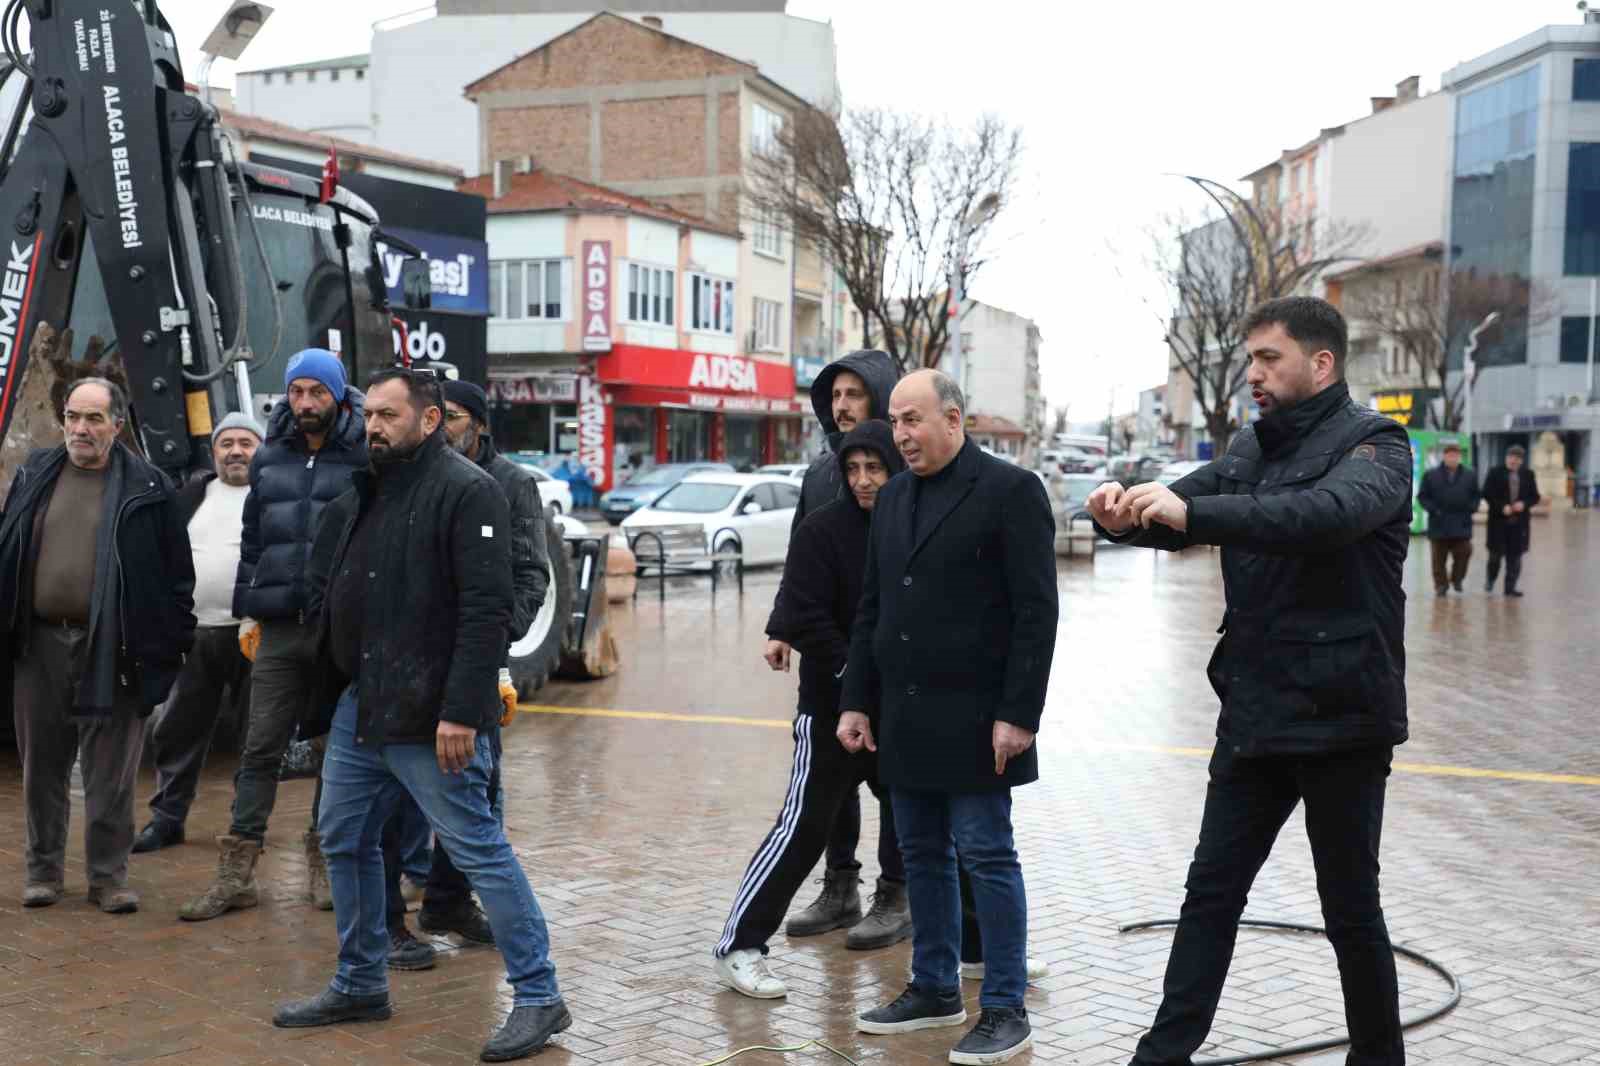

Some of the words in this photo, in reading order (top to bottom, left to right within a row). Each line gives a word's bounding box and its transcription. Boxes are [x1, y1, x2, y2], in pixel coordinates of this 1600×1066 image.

[88, 28, 101, 58] FAZLA
[102, 85, 125, 144] ALACA
[111, 146, 143, 249] BELEDİYESİ
[244, 204, 283, 222] LACA
[586, 243, 607, 335] ADSA
[688, 353, 758, 392] ADSA
